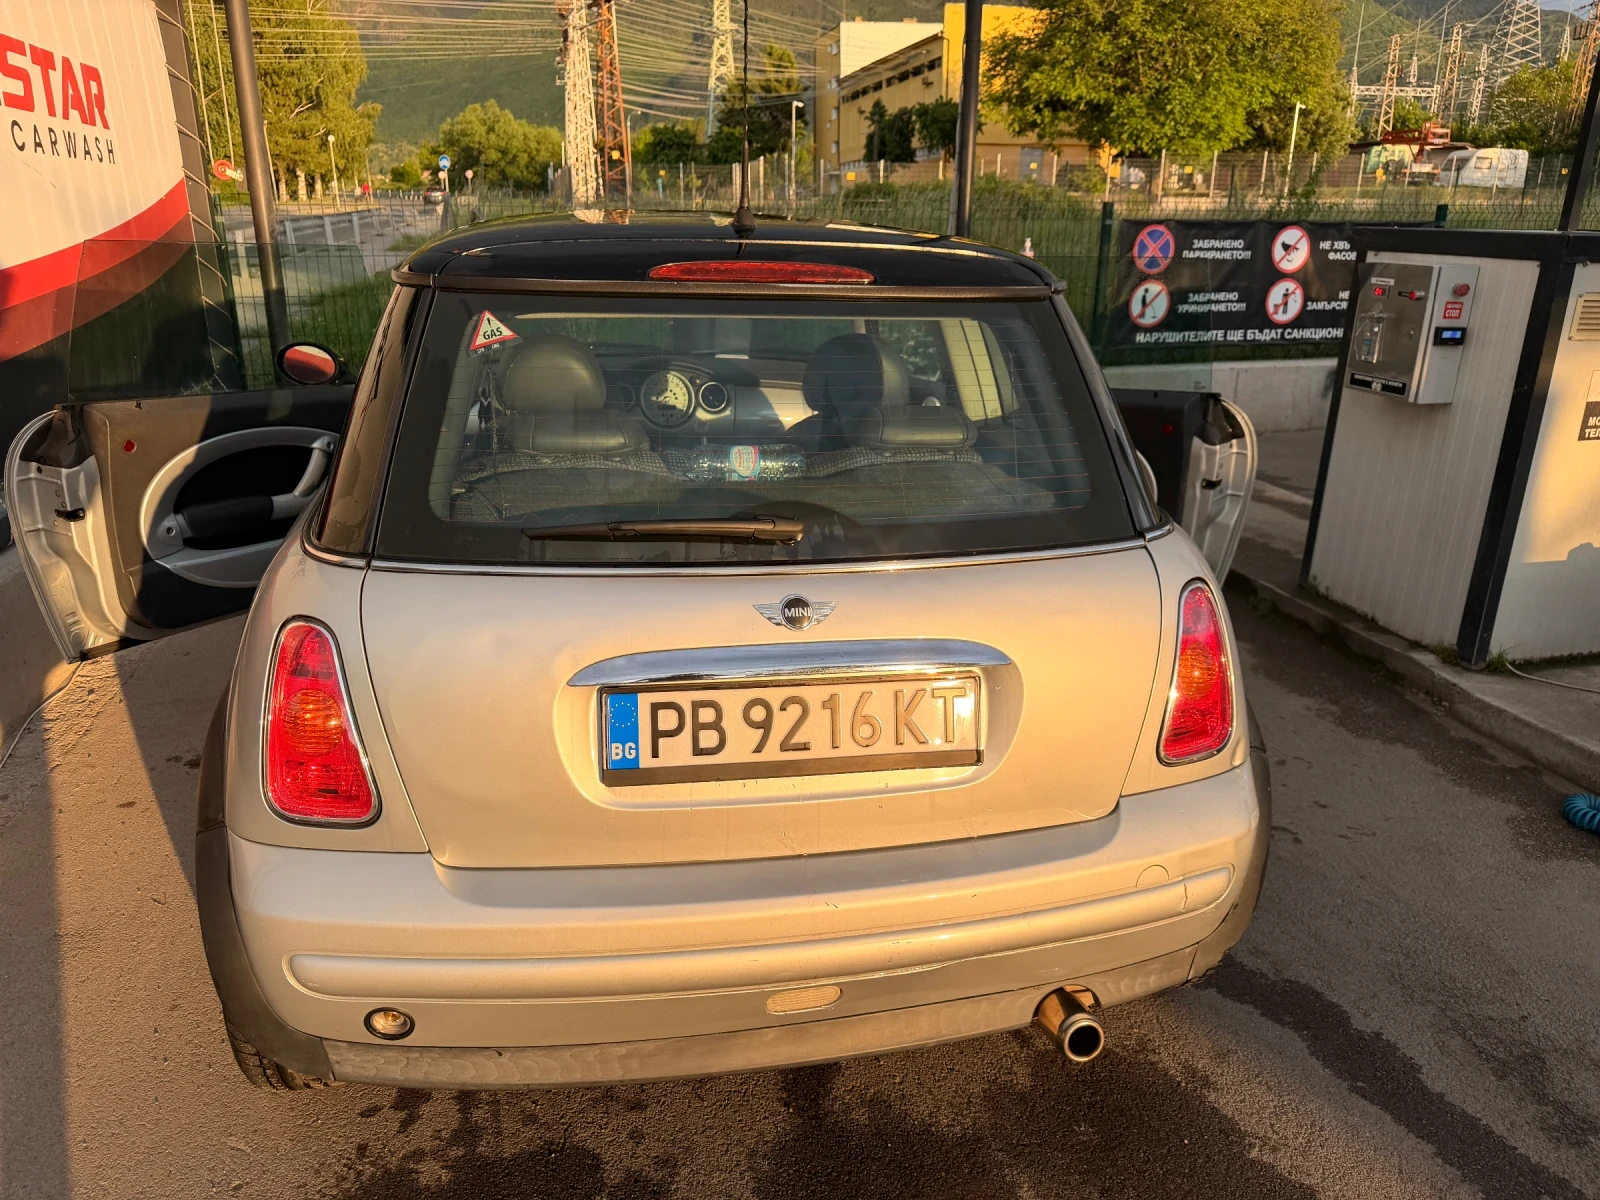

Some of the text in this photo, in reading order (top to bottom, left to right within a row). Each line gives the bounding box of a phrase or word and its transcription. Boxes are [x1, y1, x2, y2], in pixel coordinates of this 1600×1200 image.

[10, 119, 116, 165] CARWASH
[1192, 239, 1244, 249] ЗАБРАНЕНО
[1319, 240, 1331, 250] НЕ
[1187, 292, 1239, 303] ЗАБРАНЕНО
[1338, 290, 1350, 300] НЕ
[483, 327, 502, 340] GAS
[1135, 329, 1225, 343] НАРУШИТЕЛИТЕ
[1226, 329, 1245, 342] ЩЕ
[1246, 328, 1283, 342] БЪДАТ
[784, 606, 812, 618] MINI
[611, 687, 967, 760] BG PB 9216 KT
